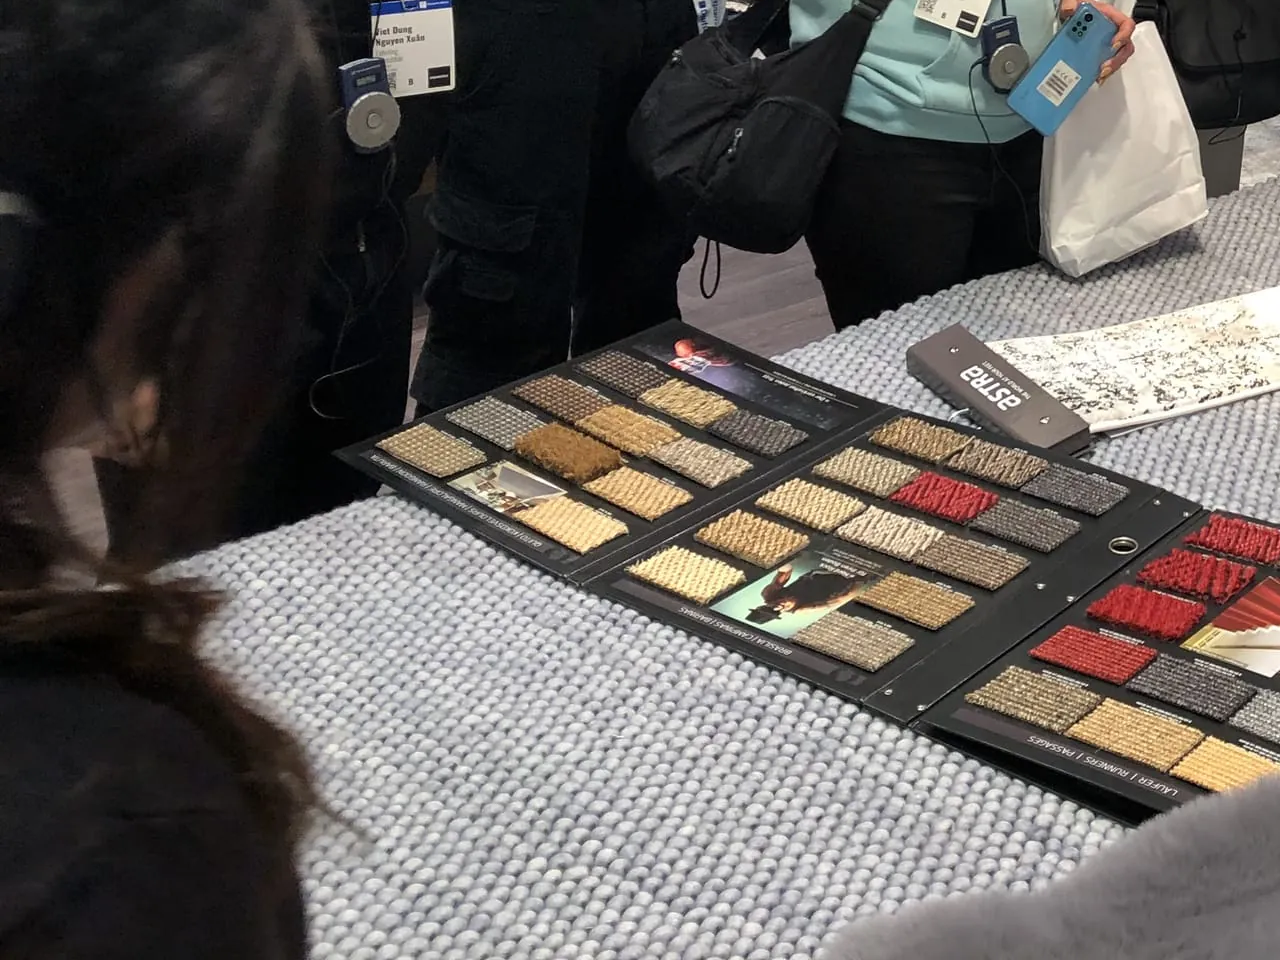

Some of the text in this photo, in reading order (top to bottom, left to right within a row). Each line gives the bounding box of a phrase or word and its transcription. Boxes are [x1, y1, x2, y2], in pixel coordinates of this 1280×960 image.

[1026, 734, 1178, 797] LÄUFER RUNNERS PASSAGES
